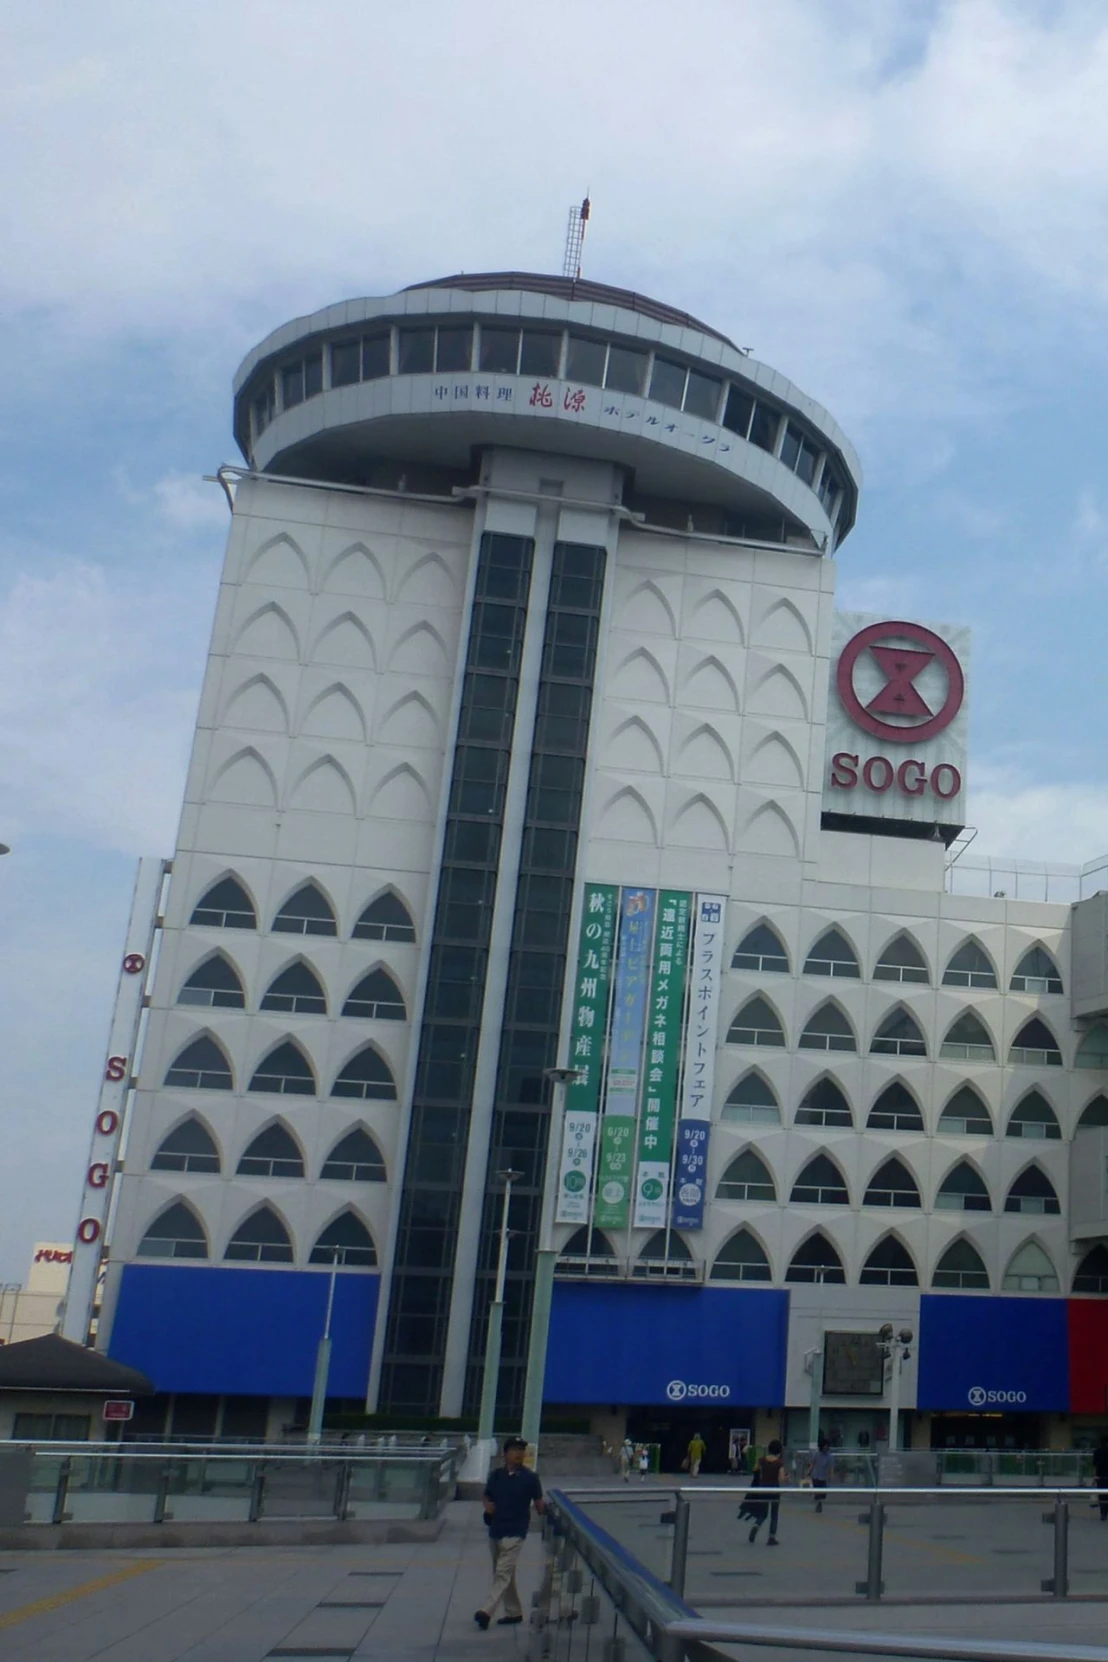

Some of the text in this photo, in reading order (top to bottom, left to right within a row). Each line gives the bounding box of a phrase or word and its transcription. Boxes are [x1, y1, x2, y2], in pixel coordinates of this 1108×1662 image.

[435, 383, 732, 452] 中国料理 桃源 ホテルオークラ
[831, 752, 962, 800] SOGO
[569, 1122, 591, 1133] 9/20
[685, 1129, 706, 1140] 9/20
[78, 1056, 128, 1244] SOGO
[682, 1154, 703, 1166] 9/30
[688, 1384, 730, 1397] SOGO
[987, 1389, 1027, 1403] SOGO
